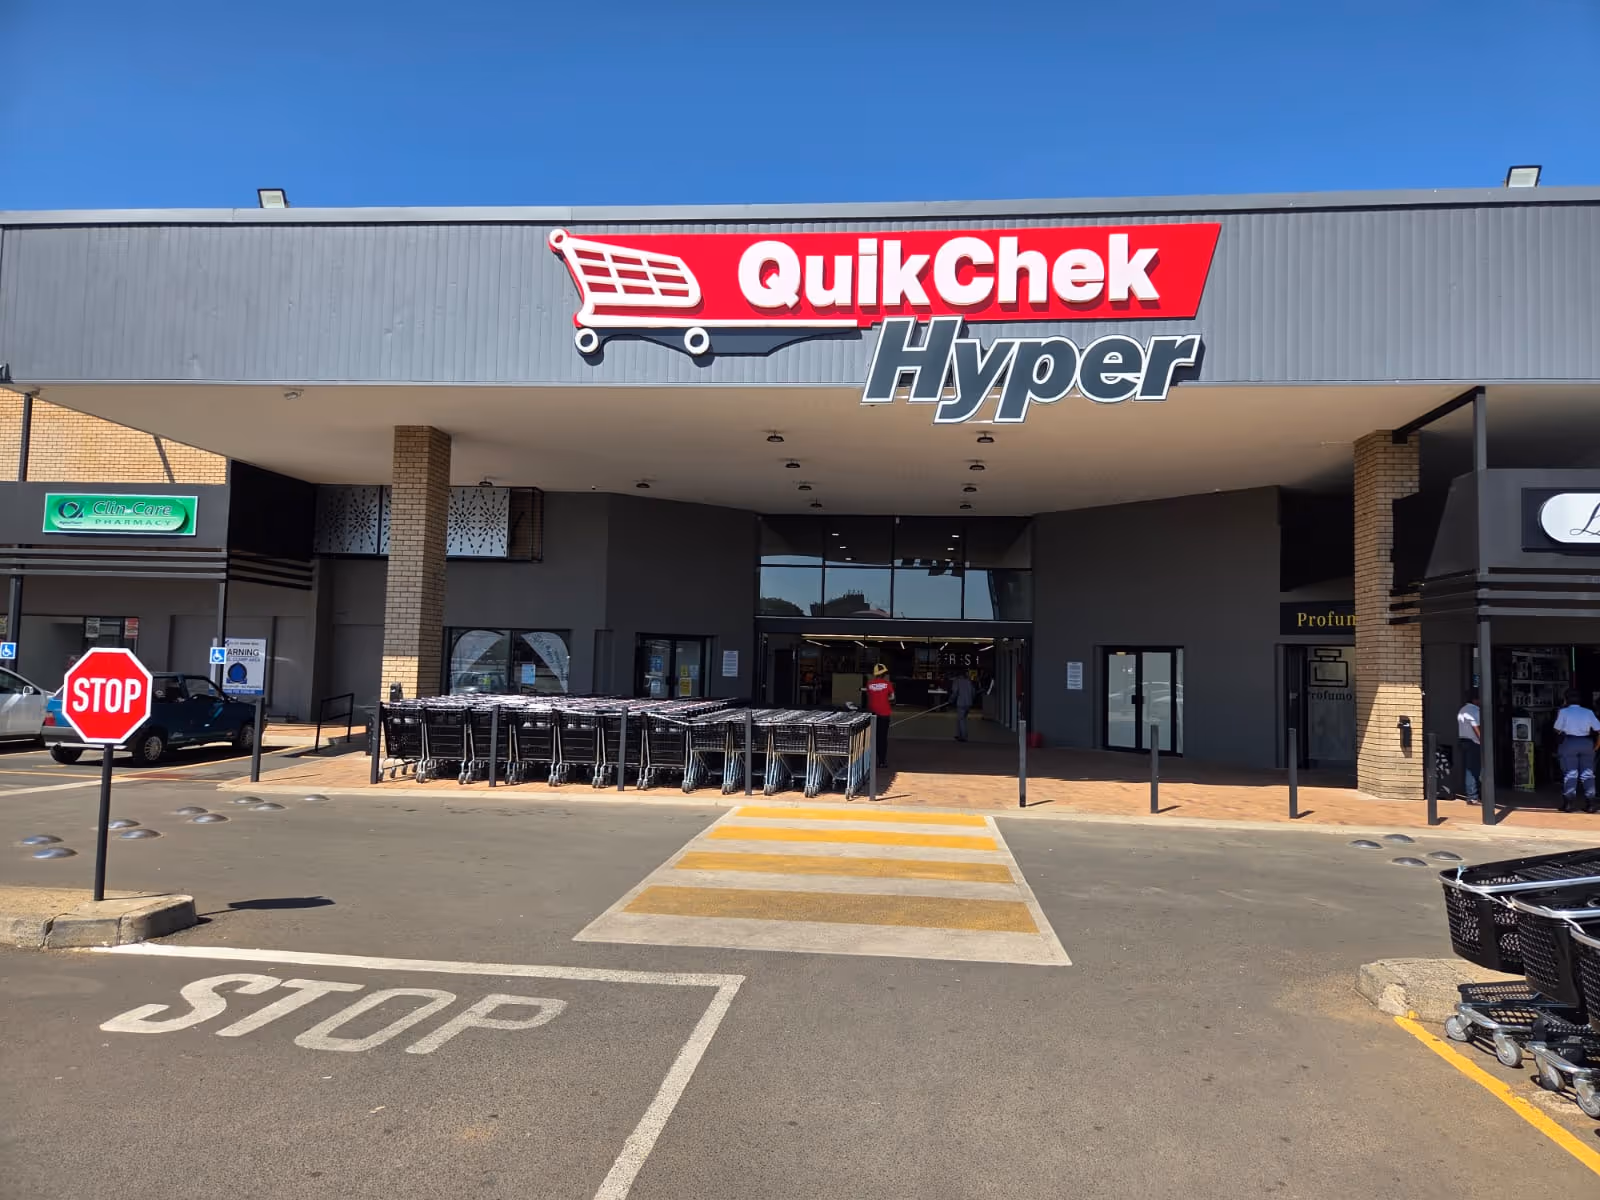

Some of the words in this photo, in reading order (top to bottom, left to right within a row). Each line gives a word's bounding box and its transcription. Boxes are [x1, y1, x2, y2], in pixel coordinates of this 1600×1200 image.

[738, 231, 1161, 310] QuikChek
[860, 315, 1201, 425] Hyper
[95, 518, 172, 526] PHARMACY
[226, 648, 260, 657] ARNING
[72, 677, 142, 713] STOP
[100, 973, 567, 1055] STOP
